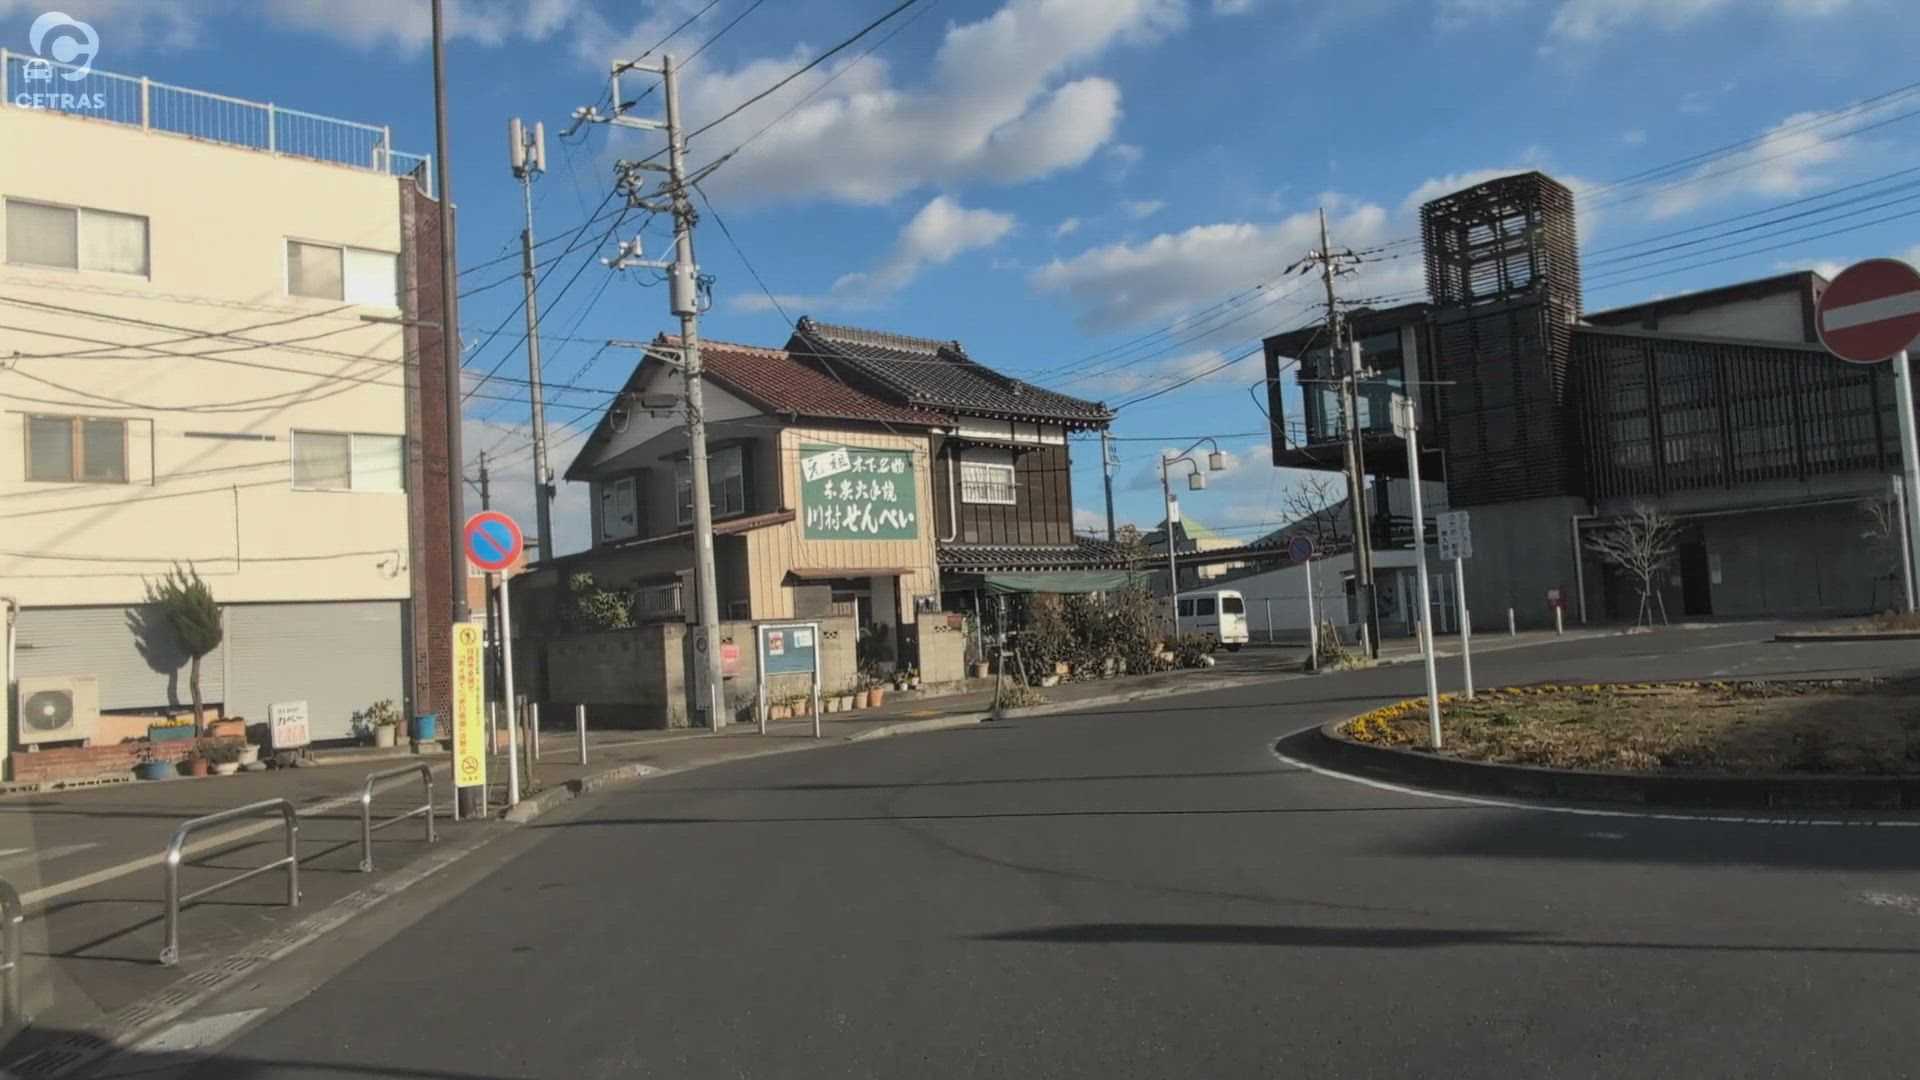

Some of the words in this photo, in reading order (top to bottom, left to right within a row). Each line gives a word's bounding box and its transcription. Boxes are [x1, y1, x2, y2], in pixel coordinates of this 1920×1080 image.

[807, 502, 915, 534] 川村せんべい
